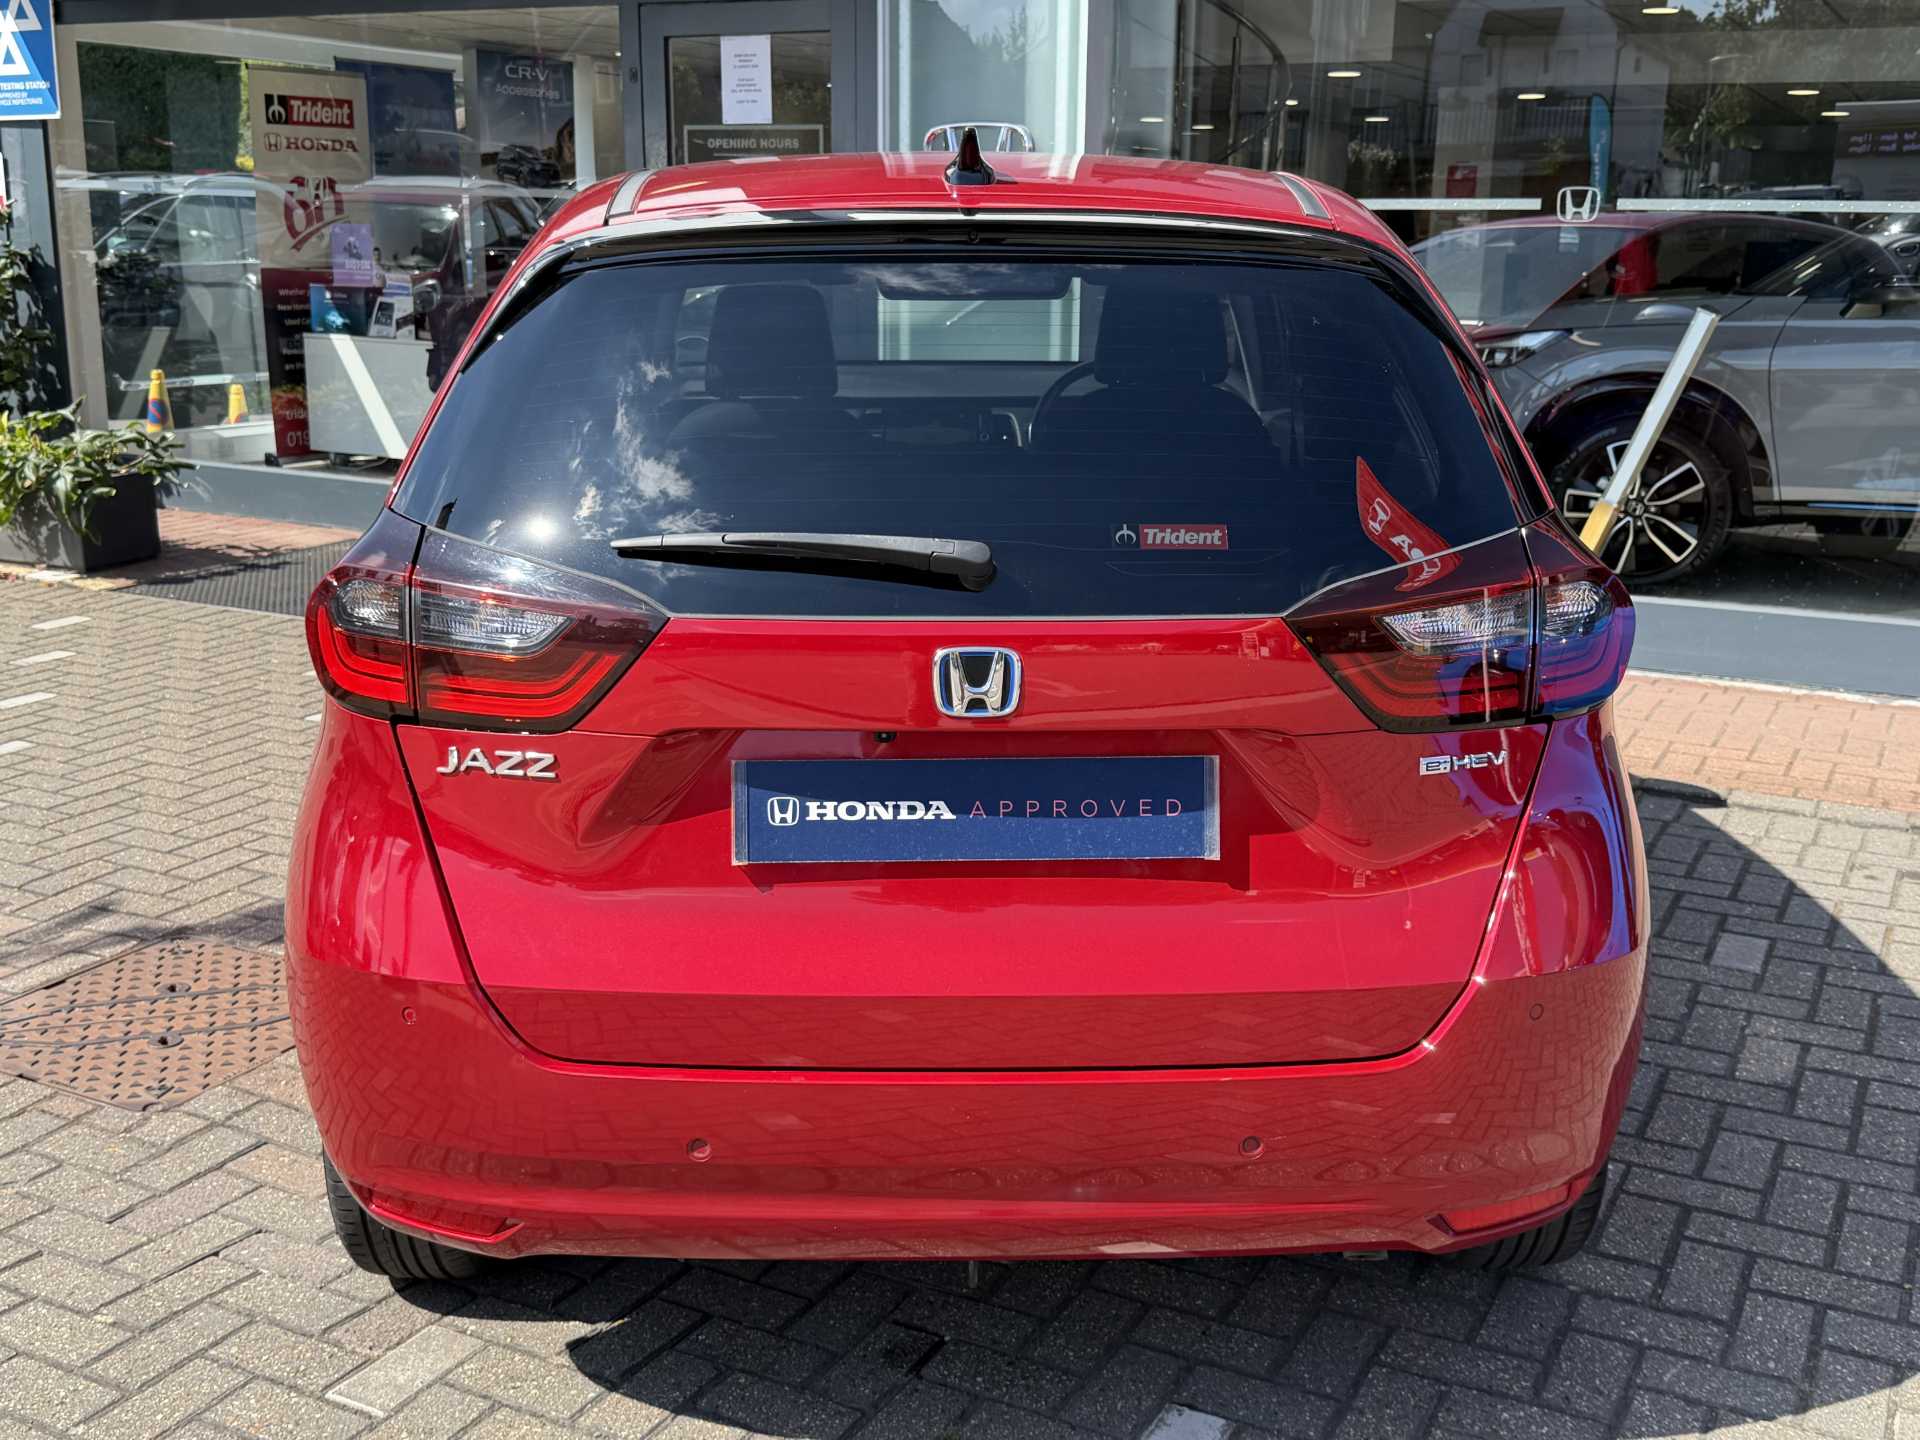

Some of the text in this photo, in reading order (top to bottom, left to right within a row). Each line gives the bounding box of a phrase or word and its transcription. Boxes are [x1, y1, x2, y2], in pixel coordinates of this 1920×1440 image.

[290, 100, 350, 125] Trident
[286, 137, 358, 153] HONDA
[707, 138, 800, 149] OPENING HOURS
[1144, 528, 1223, 545] Trident
[436, 746, 556, 778] JAZZ
[805, 799, 1183, 821] HONDA APPROVED
